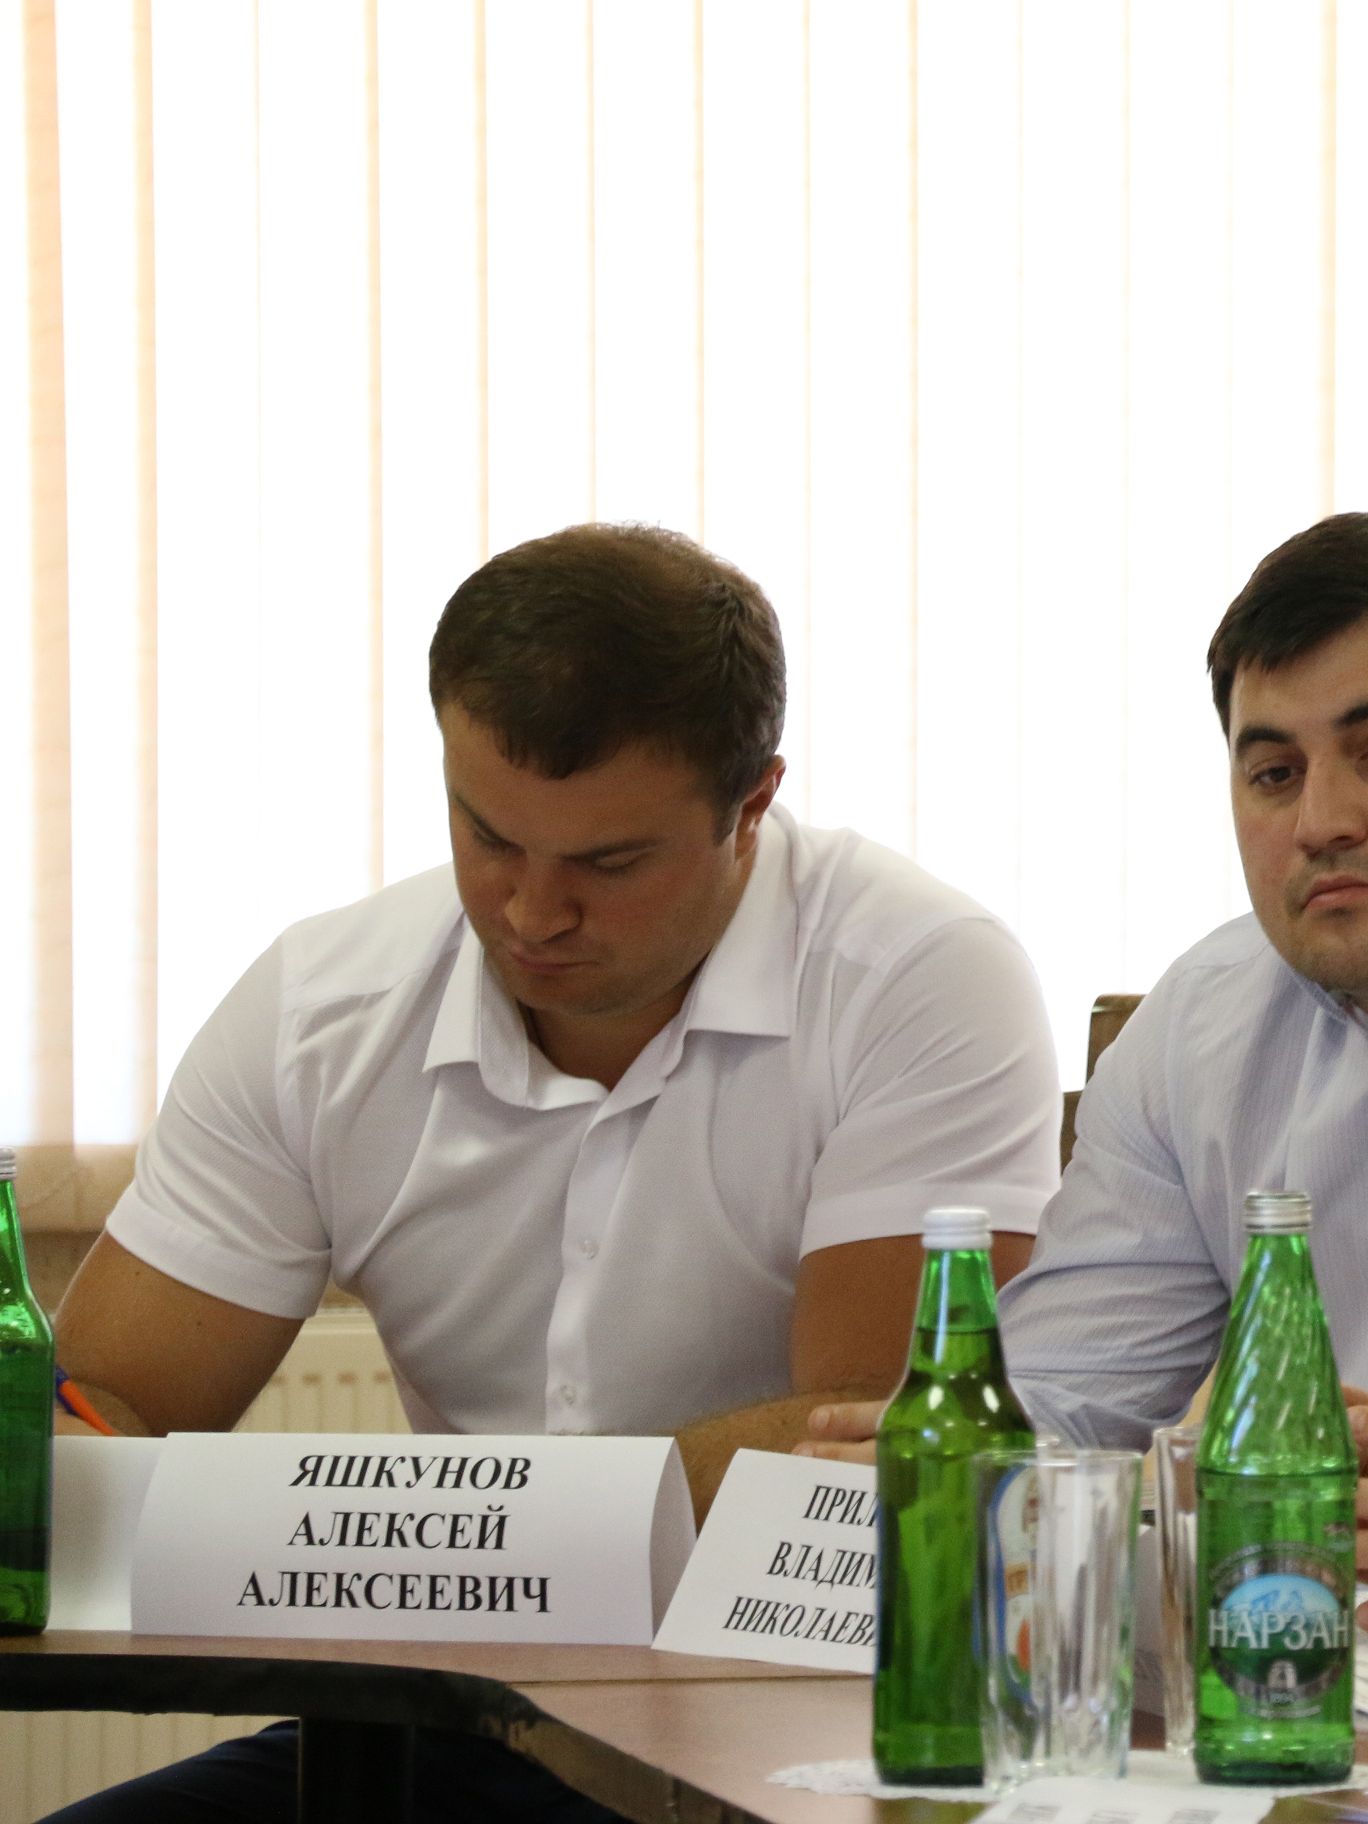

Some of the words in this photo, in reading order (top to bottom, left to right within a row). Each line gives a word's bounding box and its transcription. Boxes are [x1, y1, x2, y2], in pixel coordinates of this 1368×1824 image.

[288, 1455, 532, 1490] ЯШКУНОВ
[286, 1504, 511, 1550] АЛЕКСЕЙ
[236, 1570, 552, 1613] АЛЕКСЕЕВИЧ
[1208, 1607, 1349, 1650] НАРЗАН
